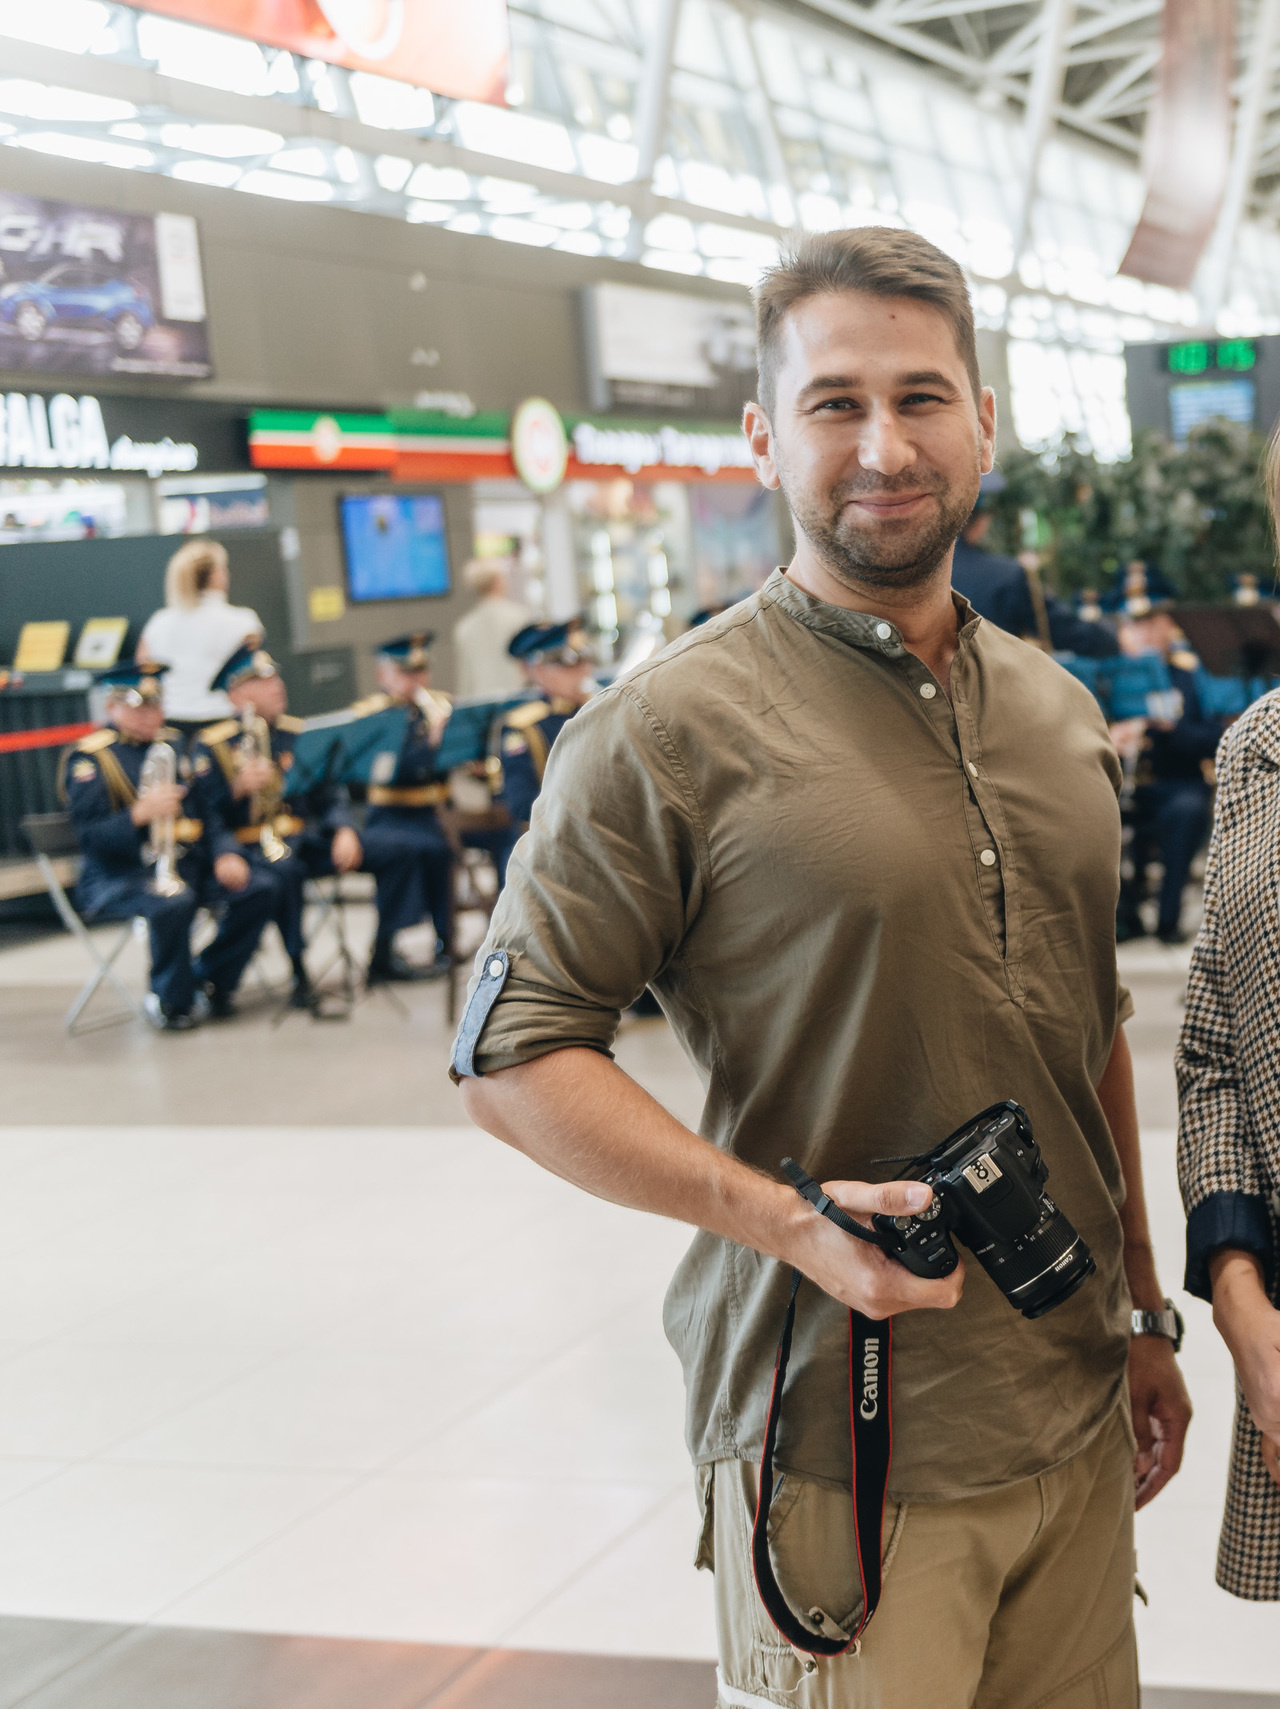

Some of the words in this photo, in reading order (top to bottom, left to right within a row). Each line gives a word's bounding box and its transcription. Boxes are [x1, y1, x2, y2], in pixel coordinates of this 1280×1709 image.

[0, 392, 110, 469] ALGA
[1054, 1253, 1074, 1272] Canon
[860, 1337, 880, 1421] Canon
